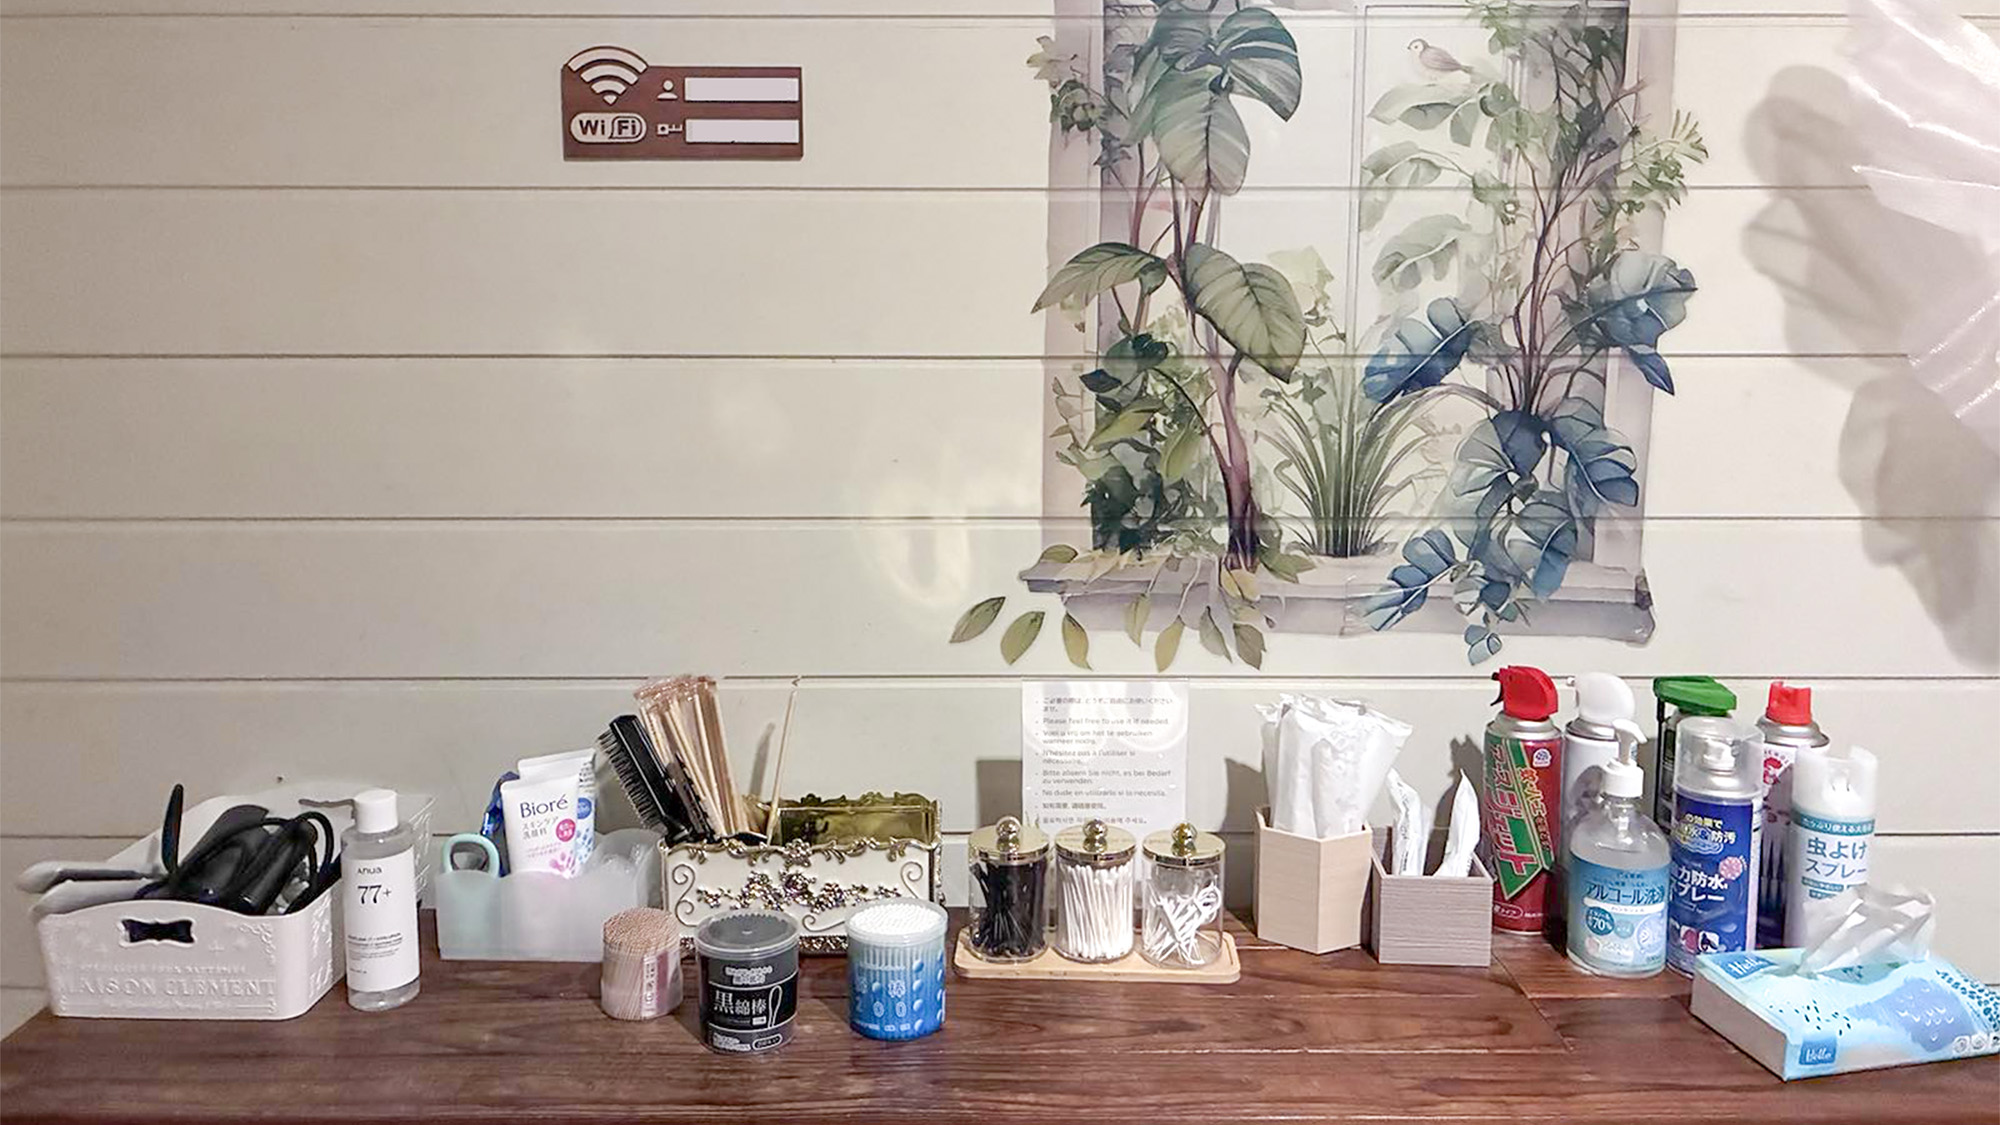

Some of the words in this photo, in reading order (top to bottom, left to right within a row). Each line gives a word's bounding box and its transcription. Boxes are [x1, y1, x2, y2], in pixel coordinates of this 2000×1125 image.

[1043, 717, 1067, 725] Please
[1068, 717, 1084, 725] feel
[1085, 717, 1100, 725] free
[1101, 717, 1110, 725] to
[1111, 717, 1125, 725] use
[1079, 730, 1091, 738] om
[1092, 730, 1105, 738] het
[1106, 730, 1115, 738] te
[1043, 769, 1061, 777] Bitte
[1088, 769, 1100, 777] Sie
[1123, 769, 1132, 777] es
[1133, 769, 1145, 777] bei
[1146, 769, 1172, 777] Bedarf
[1043, 789, 1053, 797] No
[1054, 789, 1073, 797] dude
[1074, 789, 1084, 797] en
[520, 794, 568, 818] Bioré
[1806, 837, 1868, 860] 虫よけ
[1805, 858, 1867, 879] スプレー
[357, 884, 392, 905] 77+
[713, 990, 767, 1016] 黒綿棒
